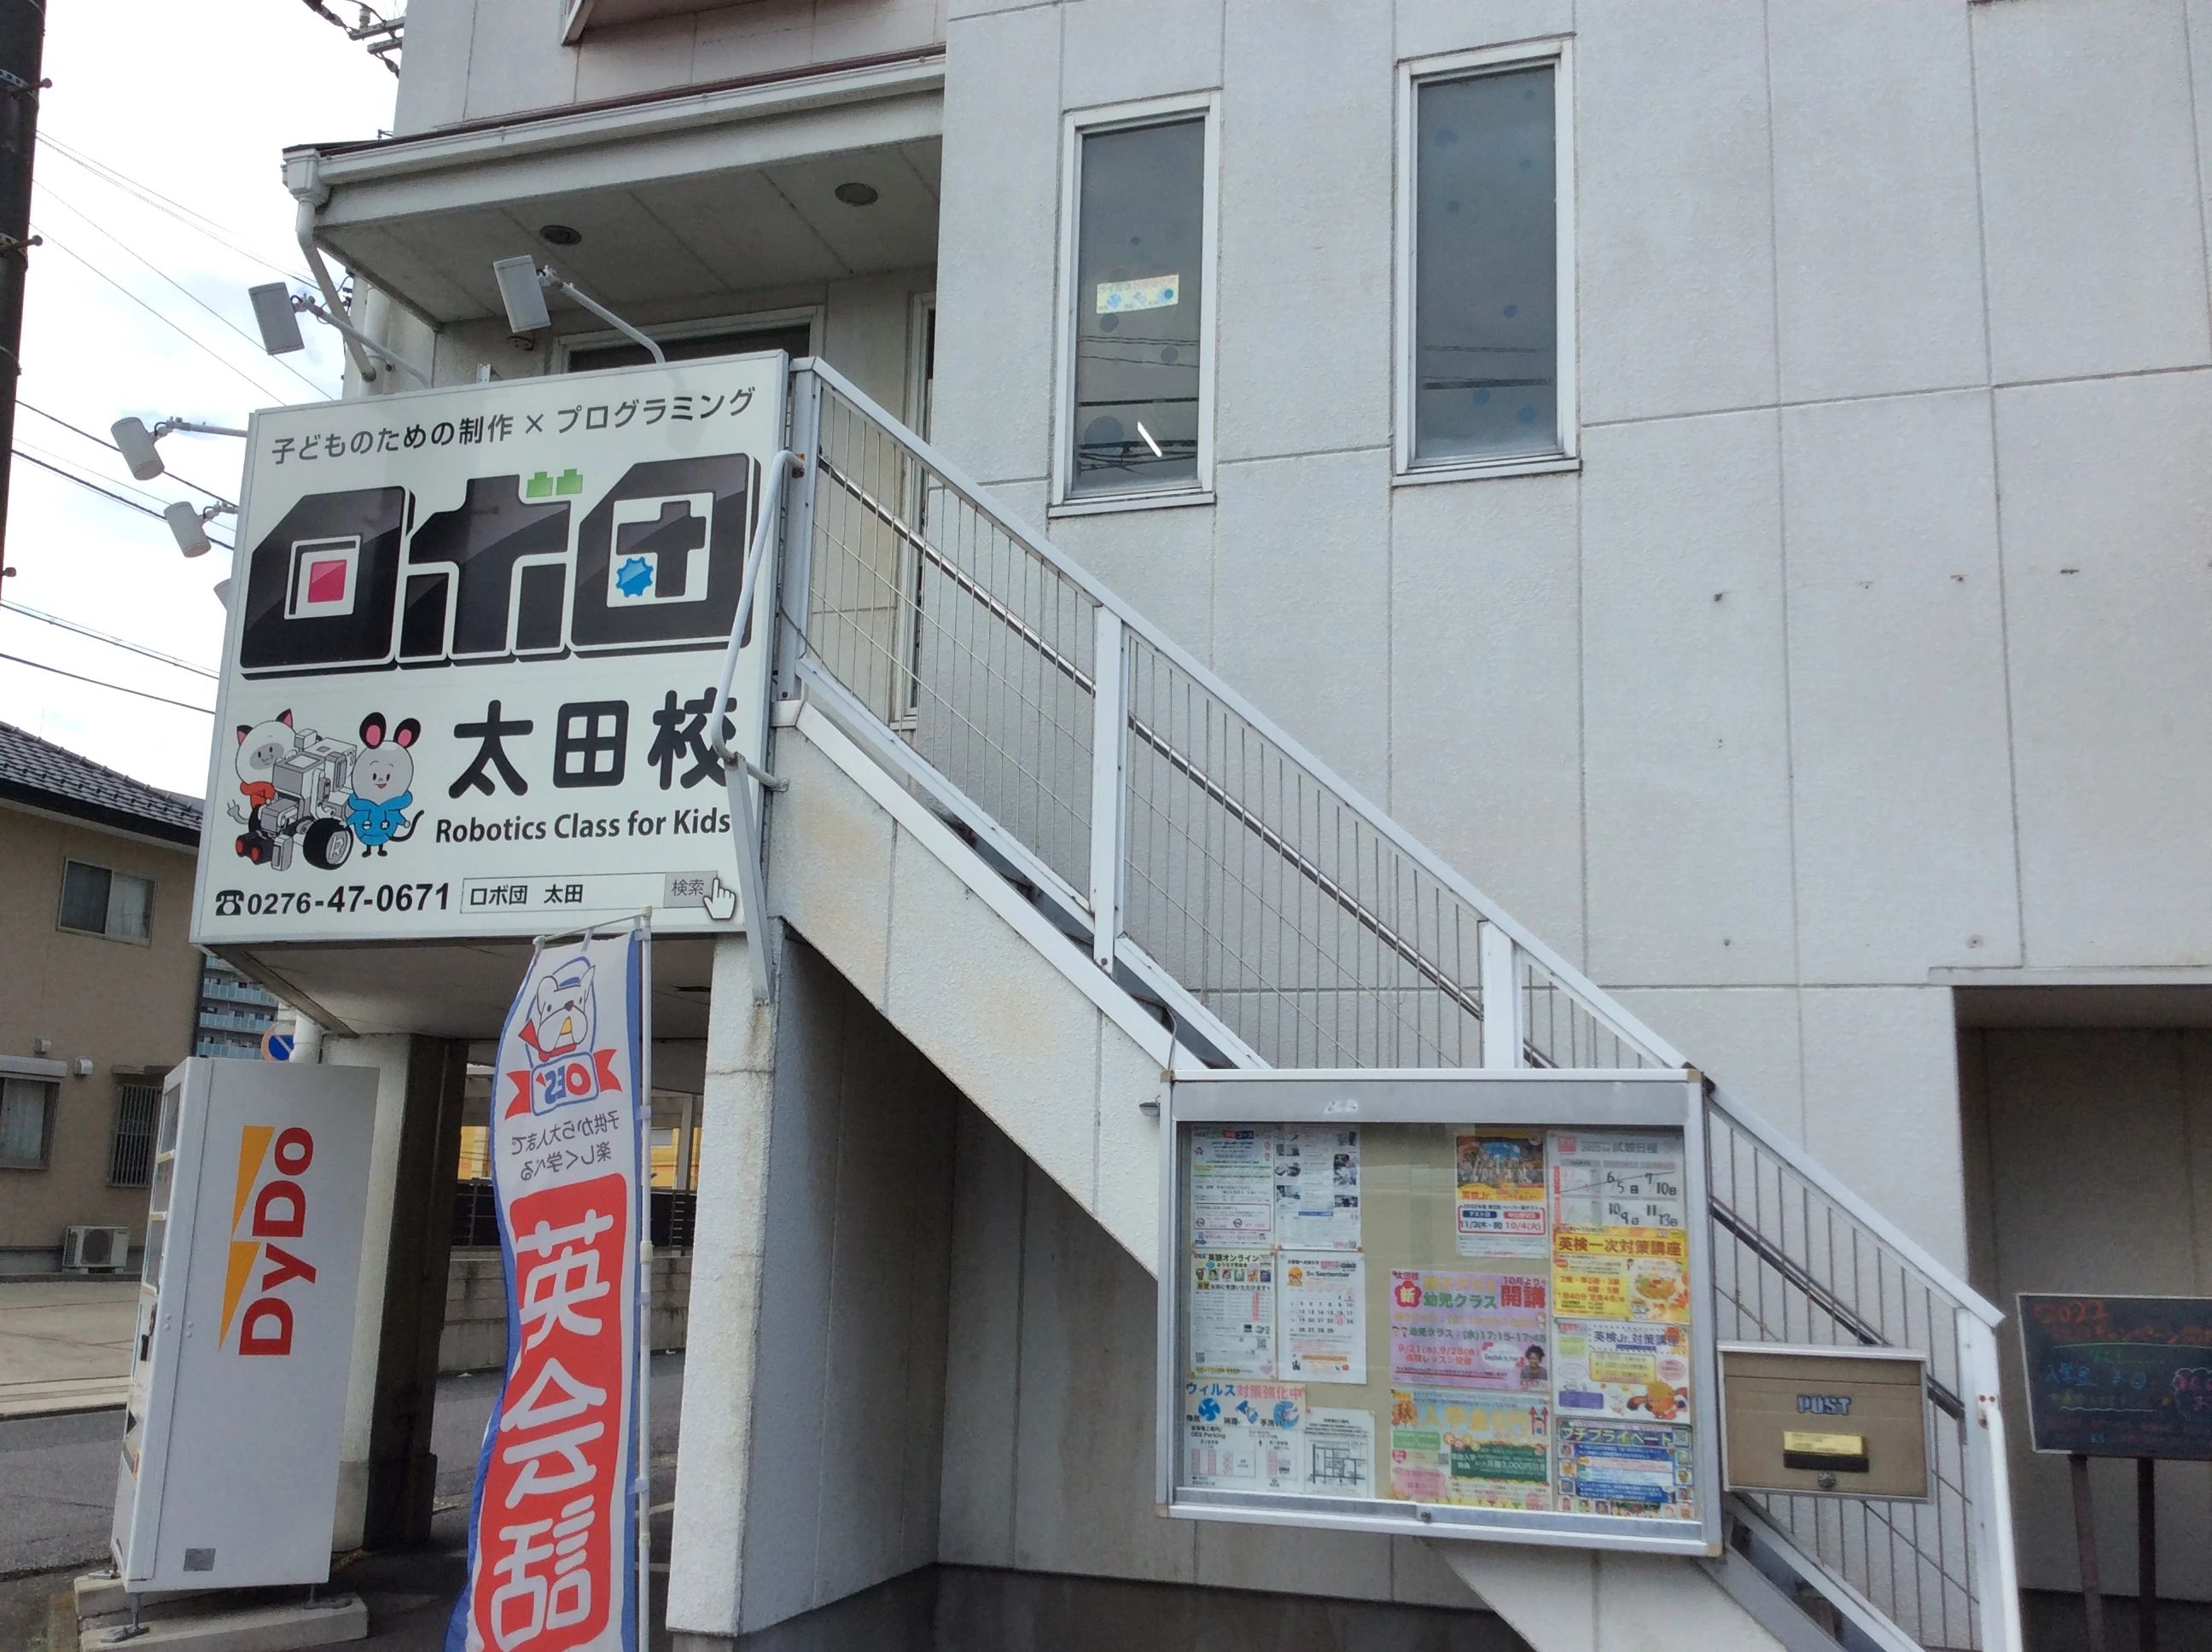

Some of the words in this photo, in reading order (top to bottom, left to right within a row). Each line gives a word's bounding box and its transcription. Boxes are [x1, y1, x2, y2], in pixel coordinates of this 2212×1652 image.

[271, 414, 514, 465] 子どものための制作
[557, 387, 756, 433] プログラミング
[448, 686, 737, 800] 太田校
[435, 817, 547, 844] Robotics
[554, 812, 621, 839] Class
[627, 810, 667, 836] for
[673, 806, 731, 835] Kids
[247, 882, 450, 916] 0276-47-0671
[470, 884, 527, 907] ロボ団
[544, 883, 584, 905] 太田
[671, 878, 705, 899] 検索
[238, 1126, 317, 1356] DyDo
[1558, 1236, 1682, 1257] 英検一次対策講座
[1400, 1286, 1416, 1304] 新
[1423, 1291, 1498, 1308] 幼児クラス
[1500, 1284, 1546, 1308] 開講
[1796, 1394, 1852, 1416] POST
